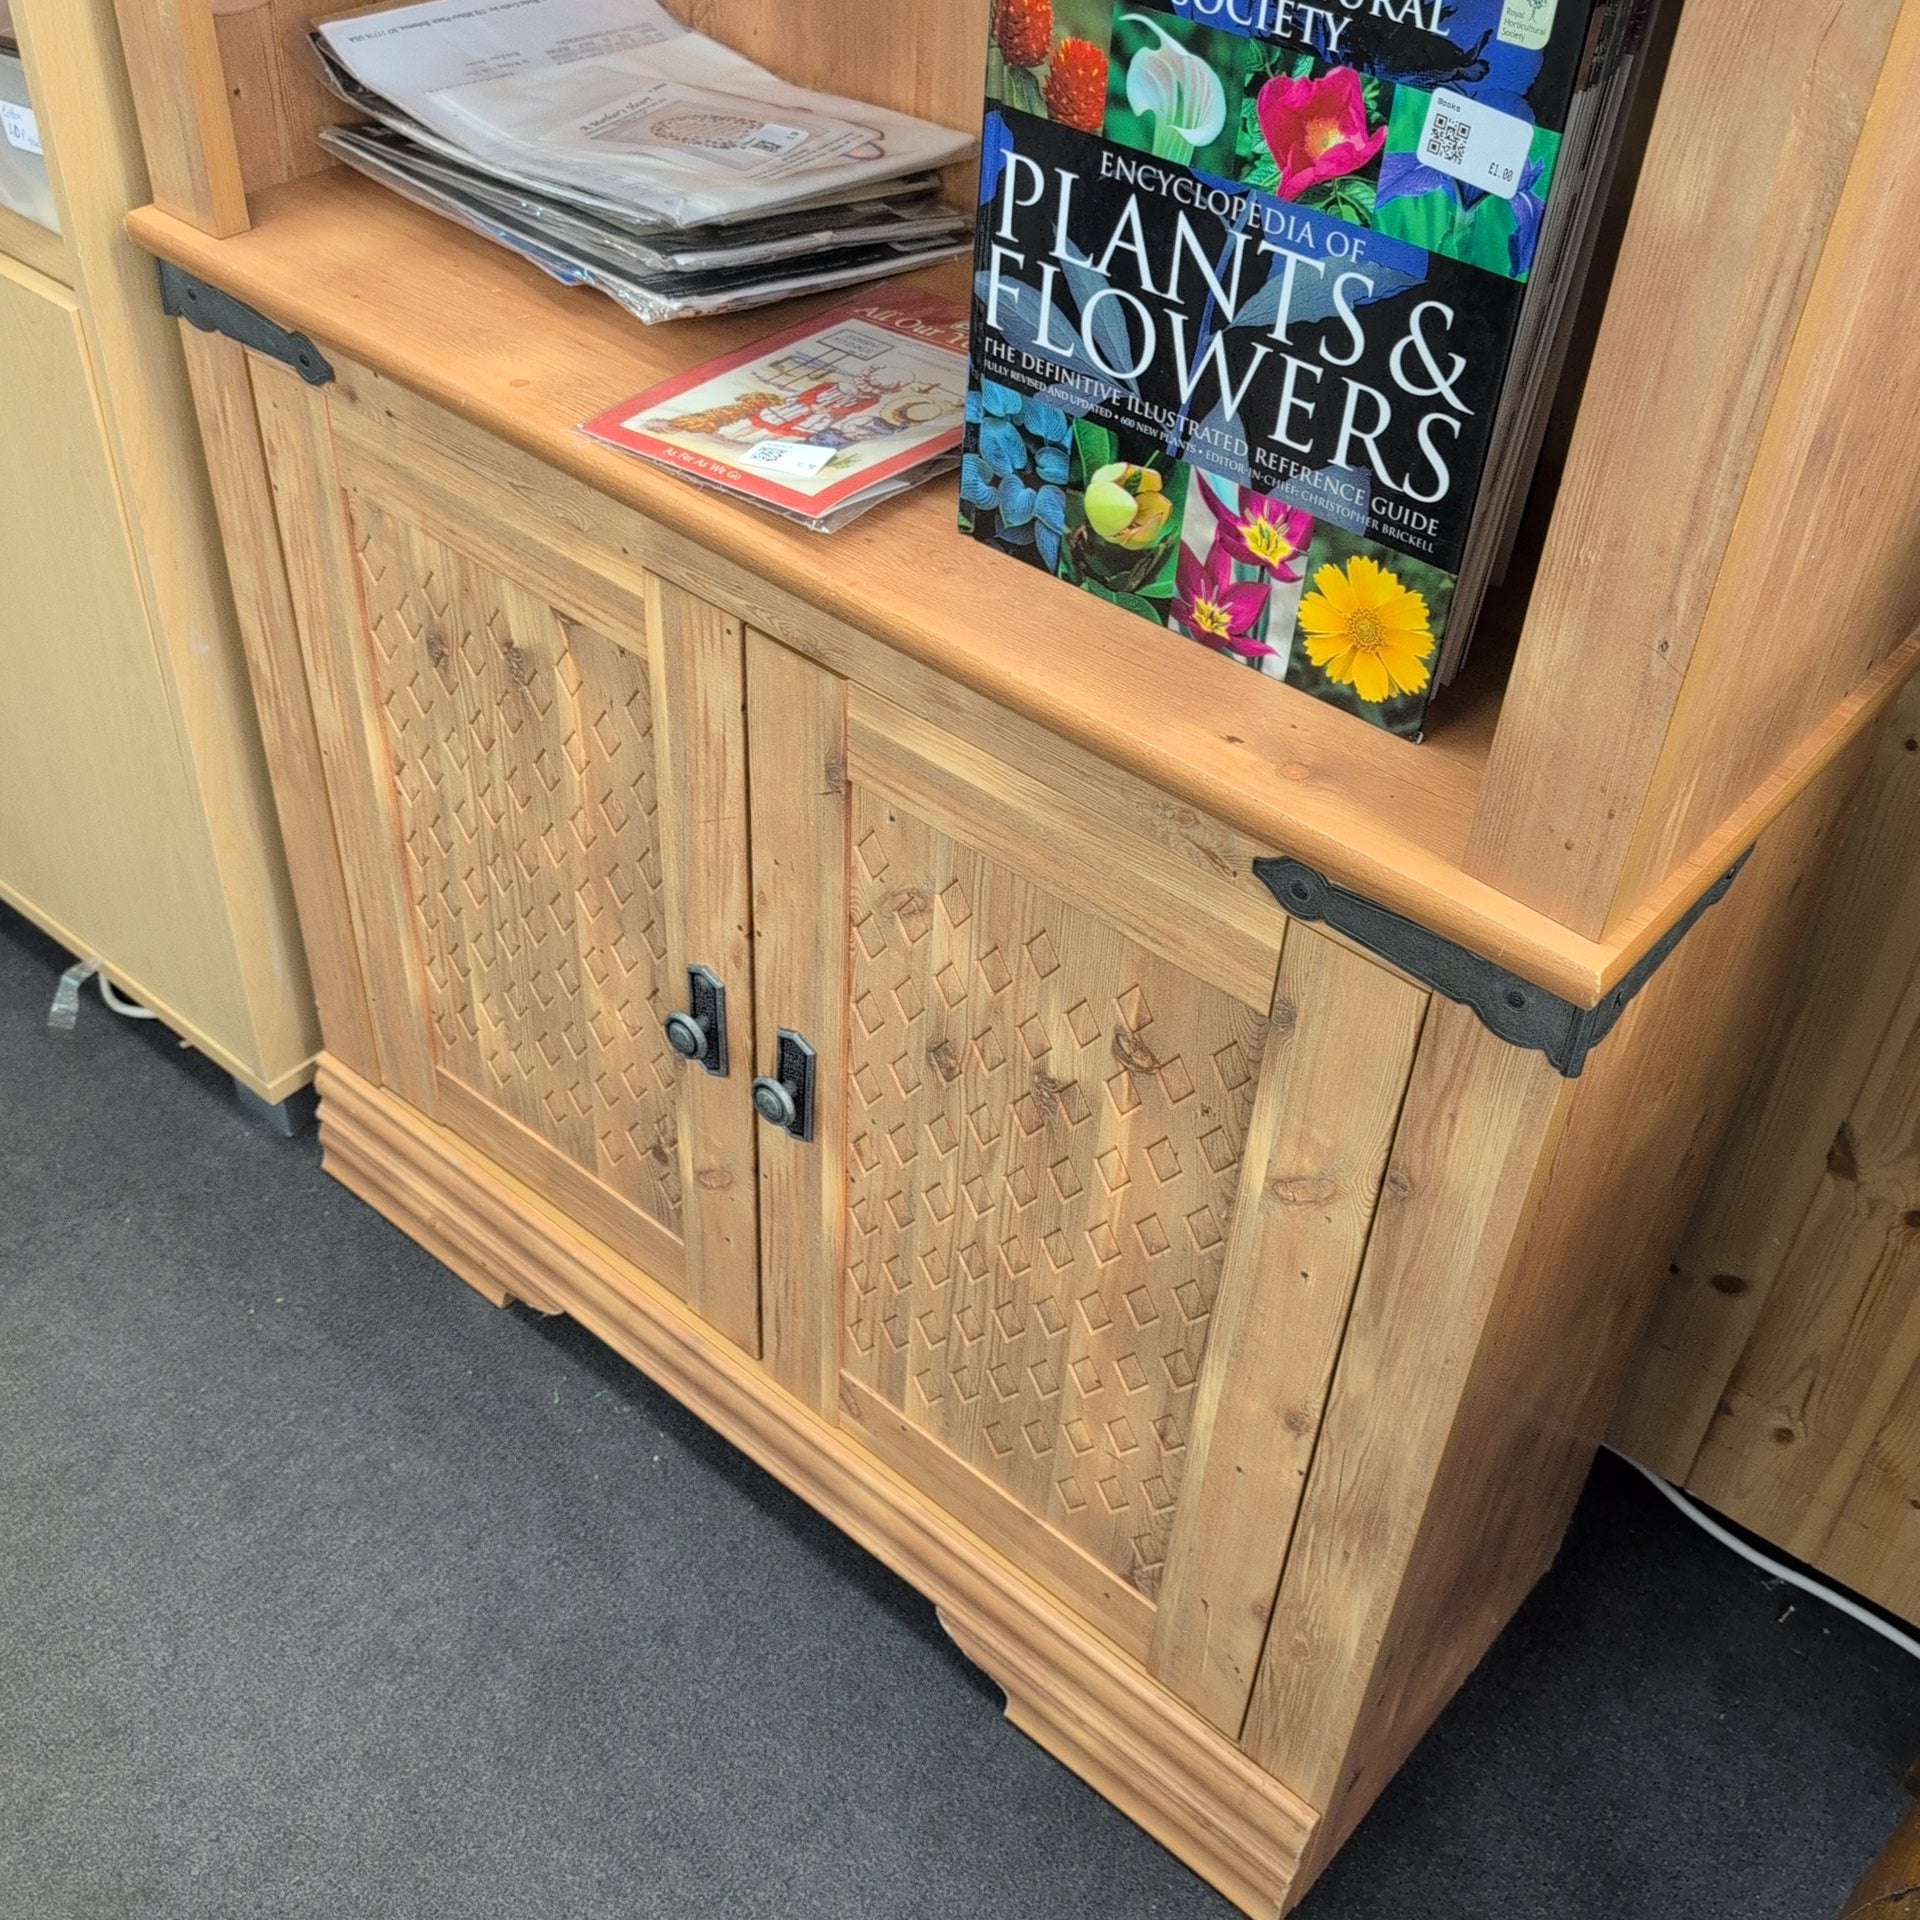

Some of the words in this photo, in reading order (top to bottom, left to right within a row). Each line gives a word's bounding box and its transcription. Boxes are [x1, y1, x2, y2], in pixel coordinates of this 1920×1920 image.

[1504, 18, 1547, 36] Horticultural
[1506, 7, 1525, 20] Royal
[1501, 28, 1526, 43] Society
[1437, 97, 1461, 113] Books
[1488, 162, 1514, 182] £1.00
[1100, 151, 1317, 249] ENCYCLOPEDIA
[1326, 231, 1367, 263] OF
[995, 148, 1376, 367] PLANTS
[1389, 300, 1475, 415] &
[853, 307, 898, 321] All
[895, 318, 945, 337] Our
[985, 242, 1463, 503] FLOWERS
[984, 336, 1016, 364] THE
[1021, 350, 1121, 407] DEFINITIVE
[1127, 393, 1249, 457] ILLUSTRATED
[1255, 447, 1367, 506] REFERENCE
[1371, 495, 1440, 537] GUIDE
[663, 447, 677, 457] As
[678, 450, 693, 463] Far
[693, 456, 708, 468] As
[710, 462, 727, 475] We
[727, 469, 742, 481] Go
[983, 359, 1009, 377] FULLY
[1010, 370, 1047, 392] REVISED
[1047, 386, 1069, 402] AND
[1069, 394, 1113, 419] UPDATED
[1120, 415, 1136, 429] 600
[1136, 422, 1159, 439] NEW
[1159, 430, 1197, 453] PLANTS
[1205, 451, 1299, 497] EDITOR-IN-CHIEF:
[1301, 490, 1380, 531] CHRISTOPHER
[1382, 522, 1434, 554] BRICKELL
